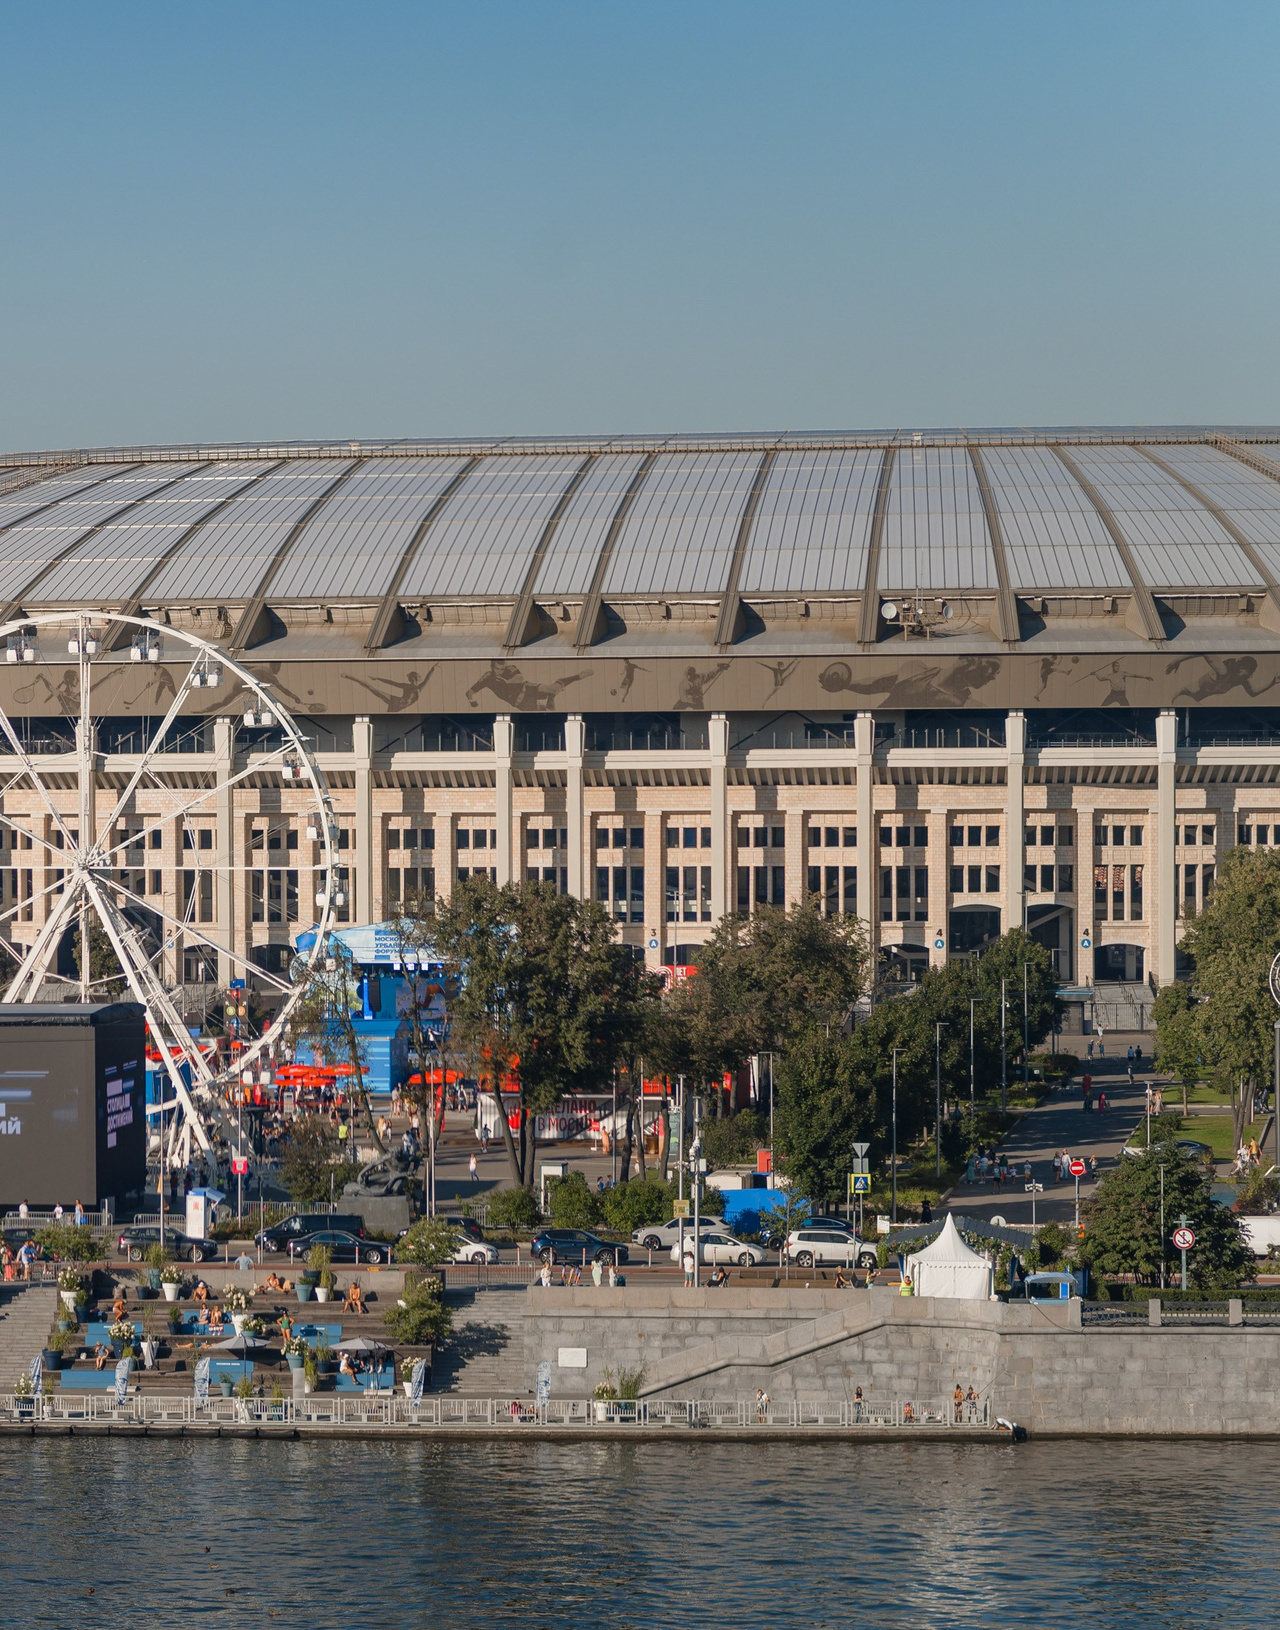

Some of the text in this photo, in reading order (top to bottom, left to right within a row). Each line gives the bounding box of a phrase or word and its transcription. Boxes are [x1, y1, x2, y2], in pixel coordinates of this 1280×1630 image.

[936, 929, 943, 937] 4
[1083, 928, 1090, 936] 4
[543, 1100, 597, 1115] ДЕЛАНО
[538, 1117, 545, 1131] В
